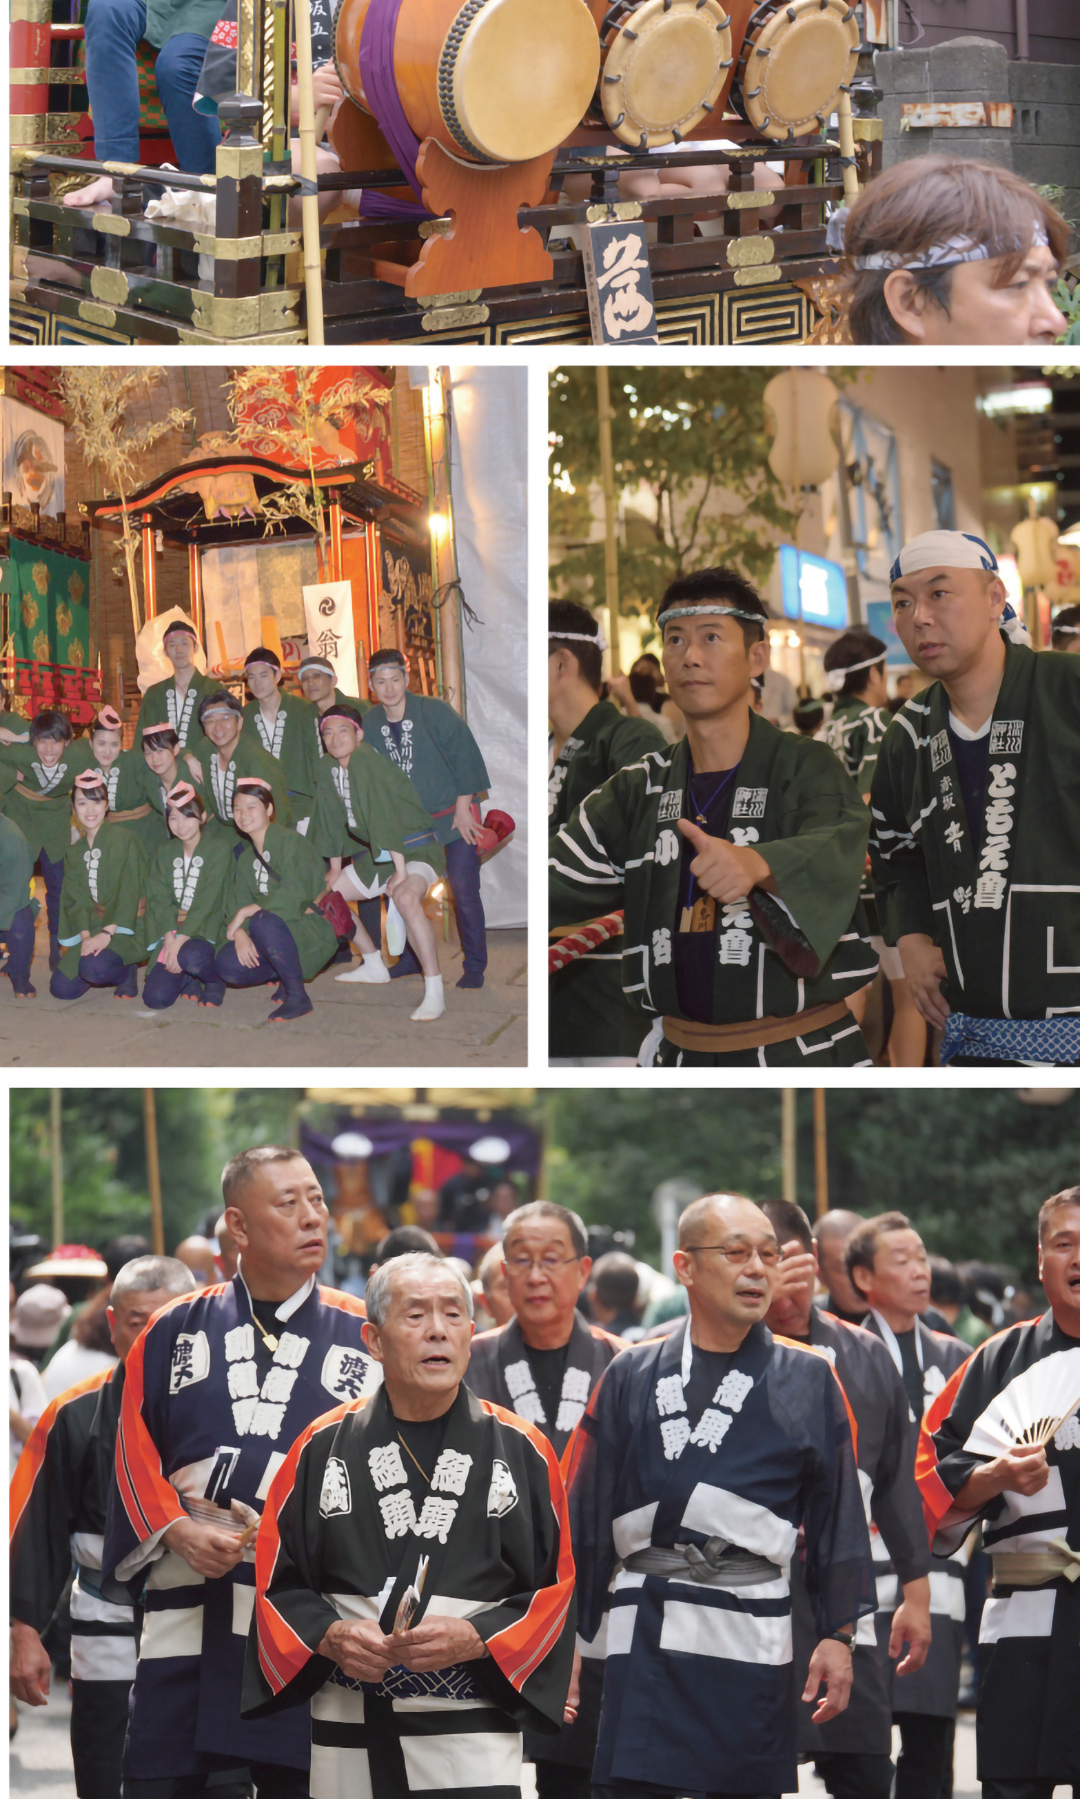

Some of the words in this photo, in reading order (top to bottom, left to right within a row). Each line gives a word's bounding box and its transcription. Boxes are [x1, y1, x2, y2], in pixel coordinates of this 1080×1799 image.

[316, 628, 343, 659] 翁
[938, 775, 957, 810] 赤坂
[973, 762, 1017, 910] ともえ會
[368, 1440, 420, 1540] 組頭
[416, 1448, 474, 1545] 組頭
